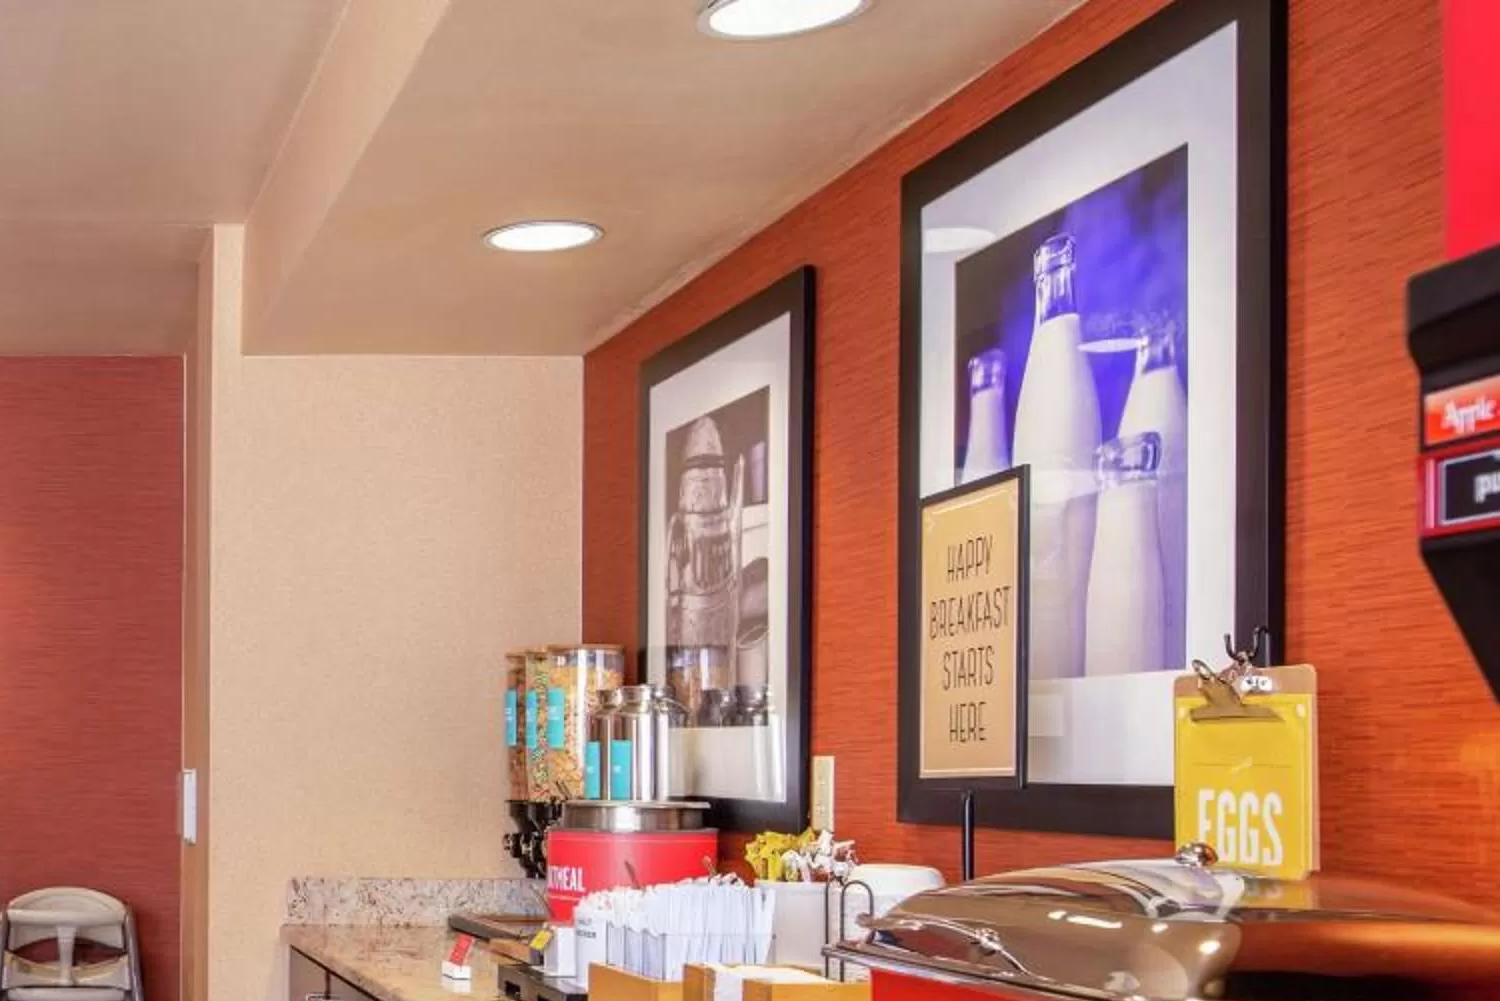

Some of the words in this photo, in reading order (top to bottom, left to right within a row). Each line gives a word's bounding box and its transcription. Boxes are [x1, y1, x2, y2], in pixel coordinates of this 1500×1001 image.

[946, 535, 992, 582] HAPPY
[930, 586, 1011, 639] BREAKFAST
[943, 645, 994, 690] STARTS
[949, 701, 986, 743] HERE
[1197, 788, 1284, 865] EGGS
